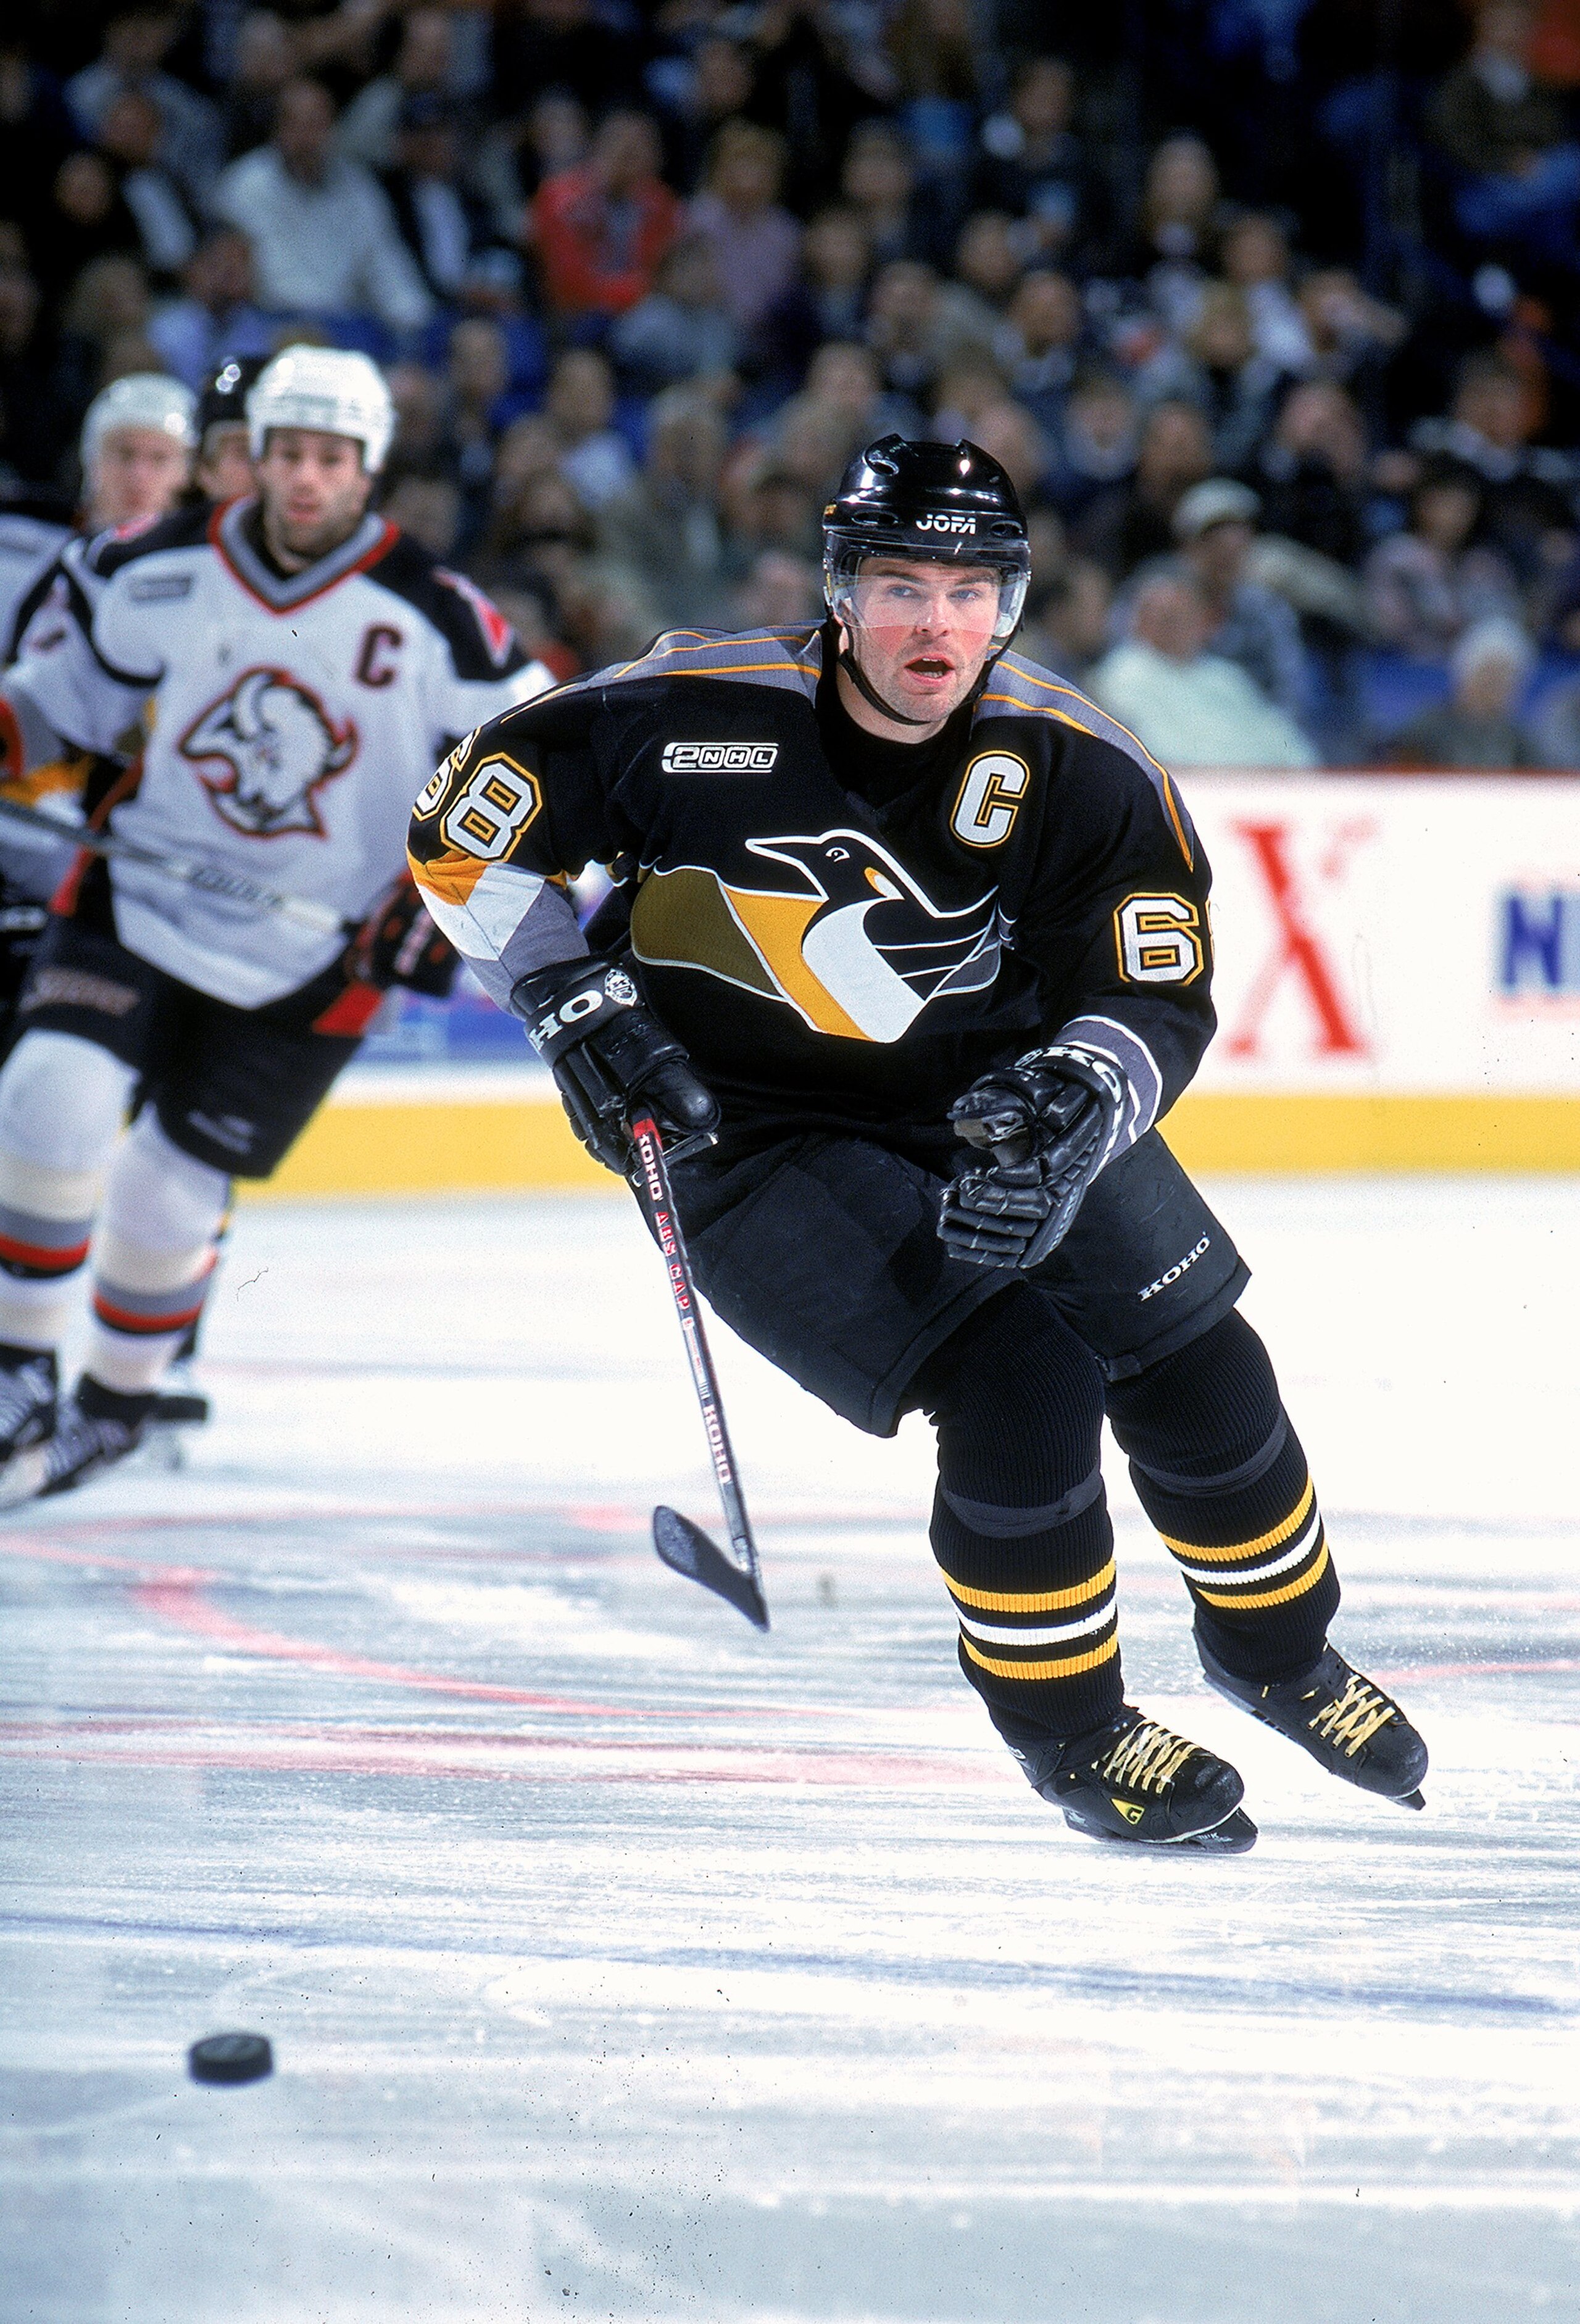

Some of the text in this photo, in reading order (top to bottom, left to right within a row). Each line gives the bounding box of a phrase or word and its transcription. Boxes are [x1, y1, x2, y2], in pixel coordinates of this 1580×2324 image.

[915, 513, 976, 535] JOFA
[357, 625, 402, 689] C
[949, 750, 1031, 849] C
[1113, 892, 1215, 986] 6
[1228, 818, 1376, 1058] X
[639, 1133, 663, 1201] KOHO
[669, 1263, 691, 1310] CAP
[1137, 1236, 1211, 1301] KOHO
[703, 1404, 732, 1484] KOHO
